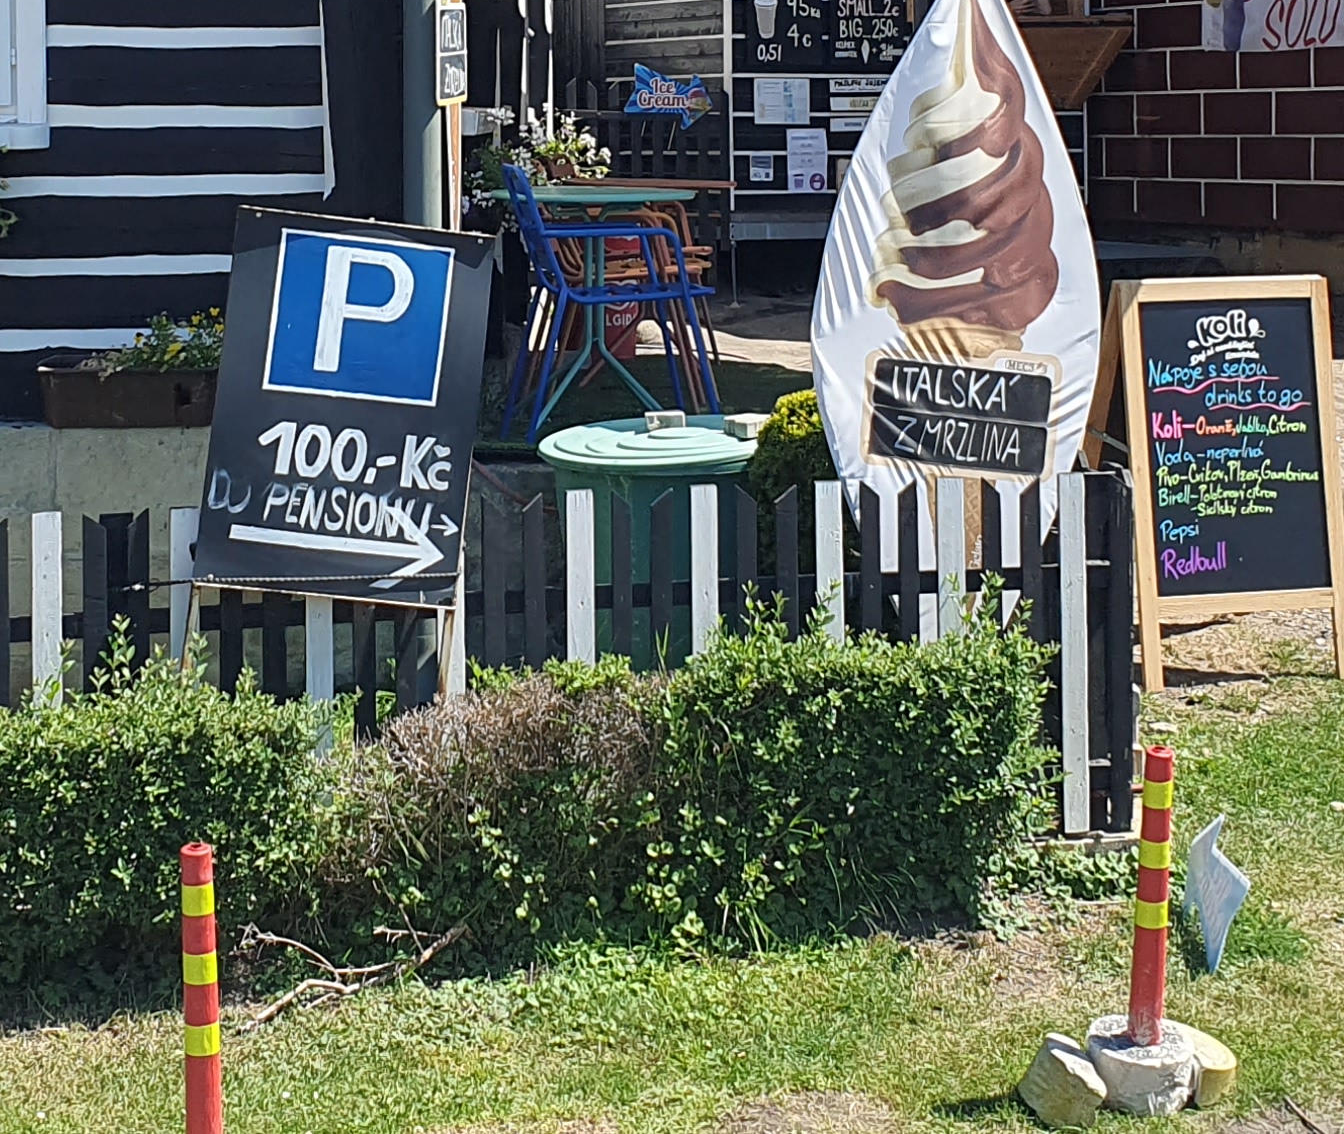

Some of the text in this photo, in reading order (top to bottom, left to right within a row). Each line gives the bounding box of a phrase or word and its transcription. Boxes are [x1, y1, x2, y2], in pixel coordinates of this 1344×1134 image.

[638, 90, 688, 108] Cream
[651, 77, 675, 94] Ice
[313, 245, 415, 373] P
[605, 313, 637, 327] LGID
[1197, 310, 1248, 347] Koli
[1148, 359, 1268, 388] Nápoje s sebou
[892, 365, 1022, 413] ITALSKÁ
[1205, 381, 1303, 409] drinks to go
[893, 415, 1022, 467] ZMRZLINA
[1155, 438, 1195, 466] Voda
[1159, 518, 1200, 545] Pepsi
[1160, 540, 1227, 581] Redbull
